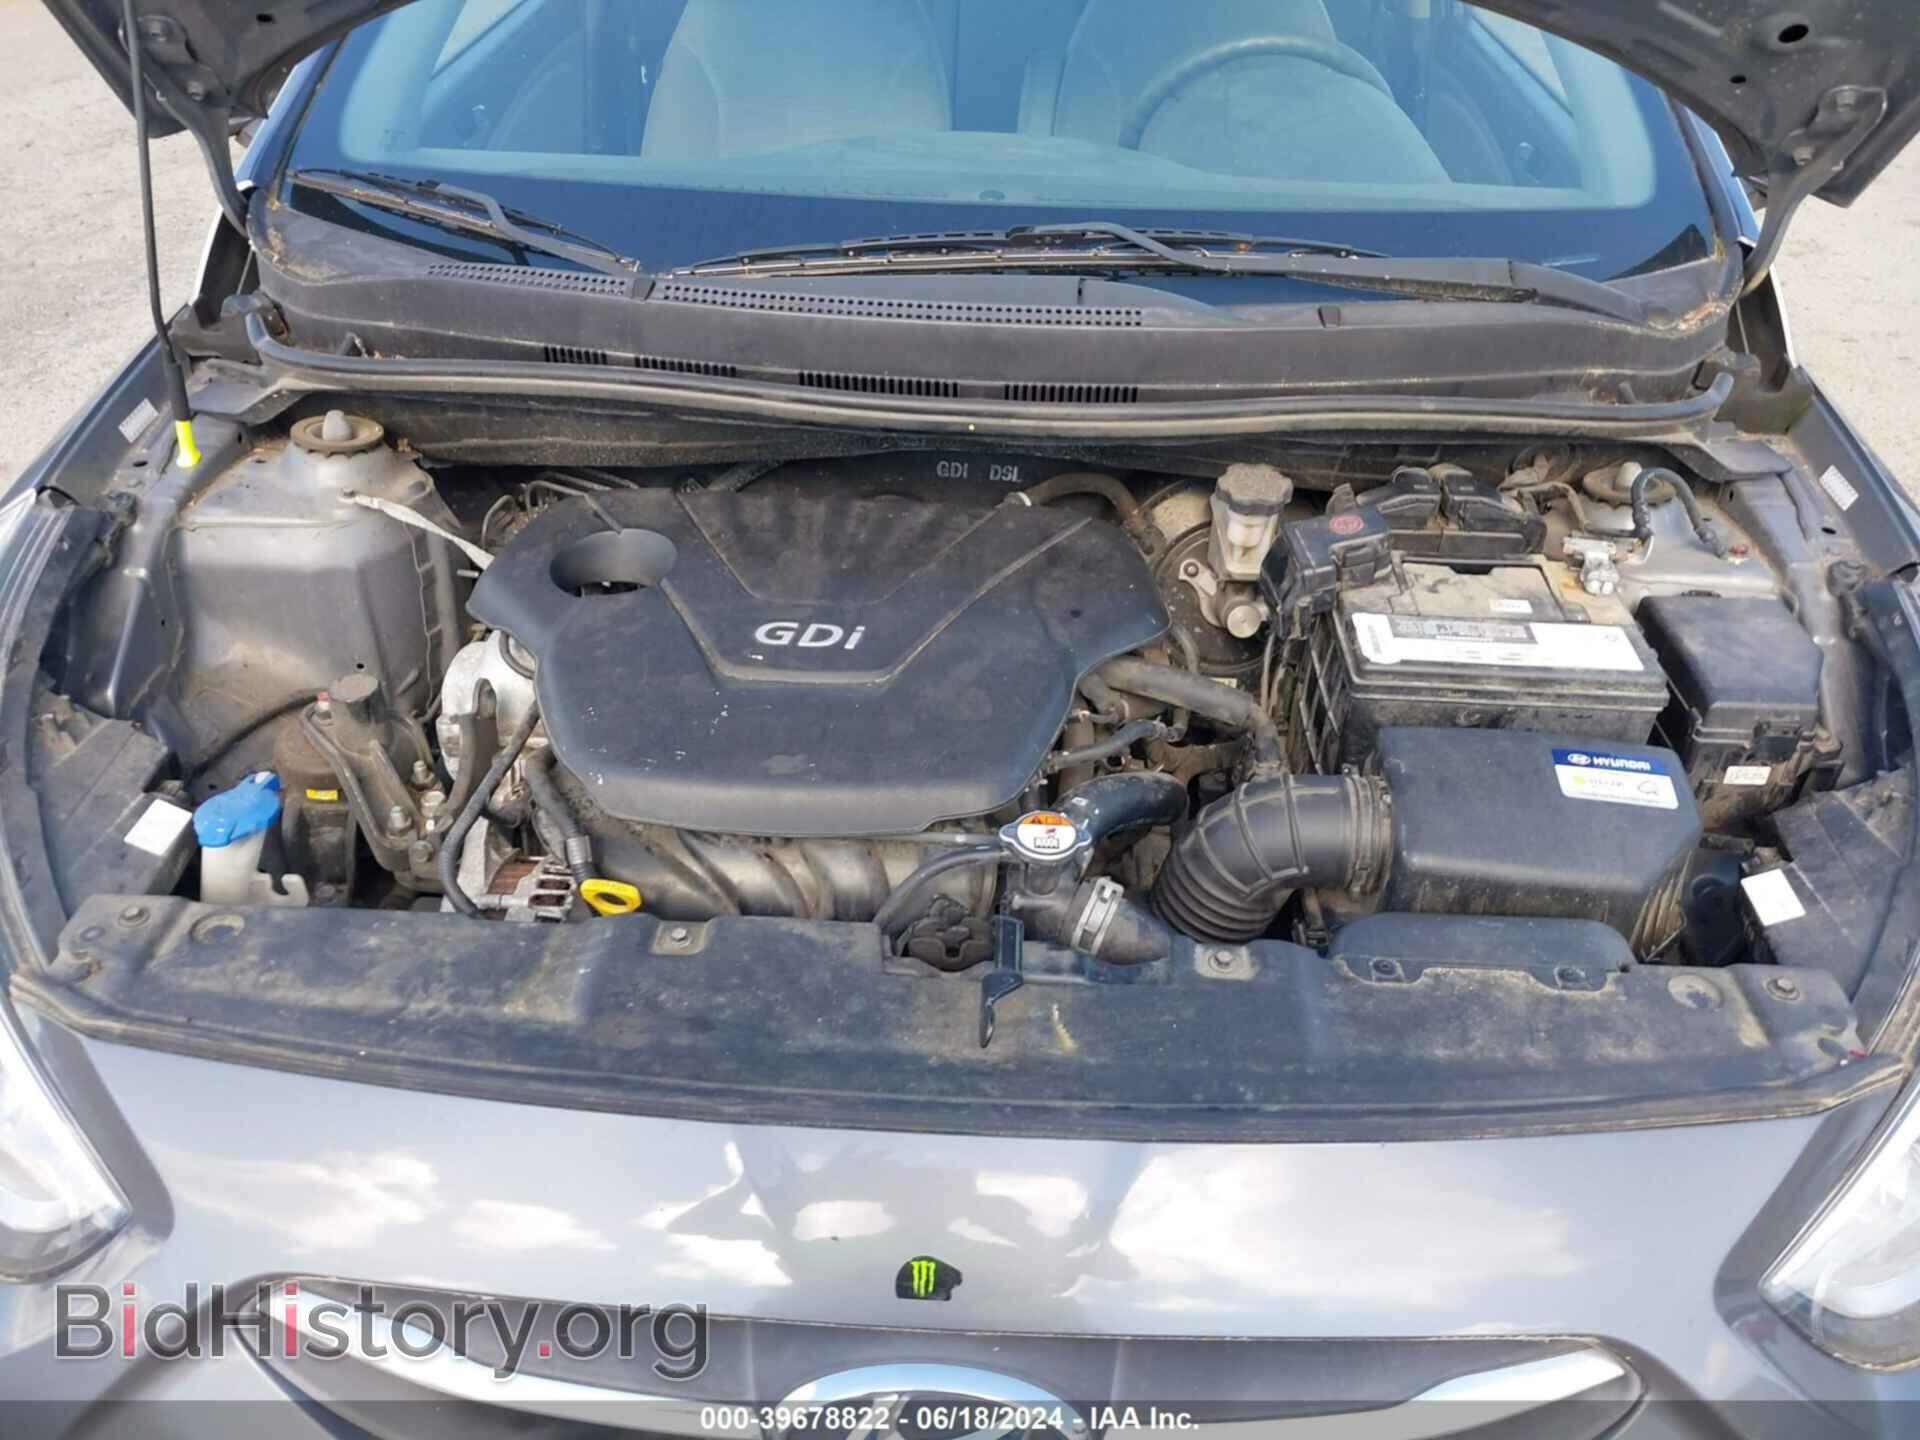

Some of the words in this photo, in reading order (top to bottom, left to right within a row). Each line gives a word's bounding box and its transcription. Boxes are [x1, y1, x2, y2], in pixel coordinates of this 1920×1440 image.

[936, 460, 969, 479] GDI
[754, 621, 866, 650] GDi
[1592, 755, 1652, 771] HYUNDAI
